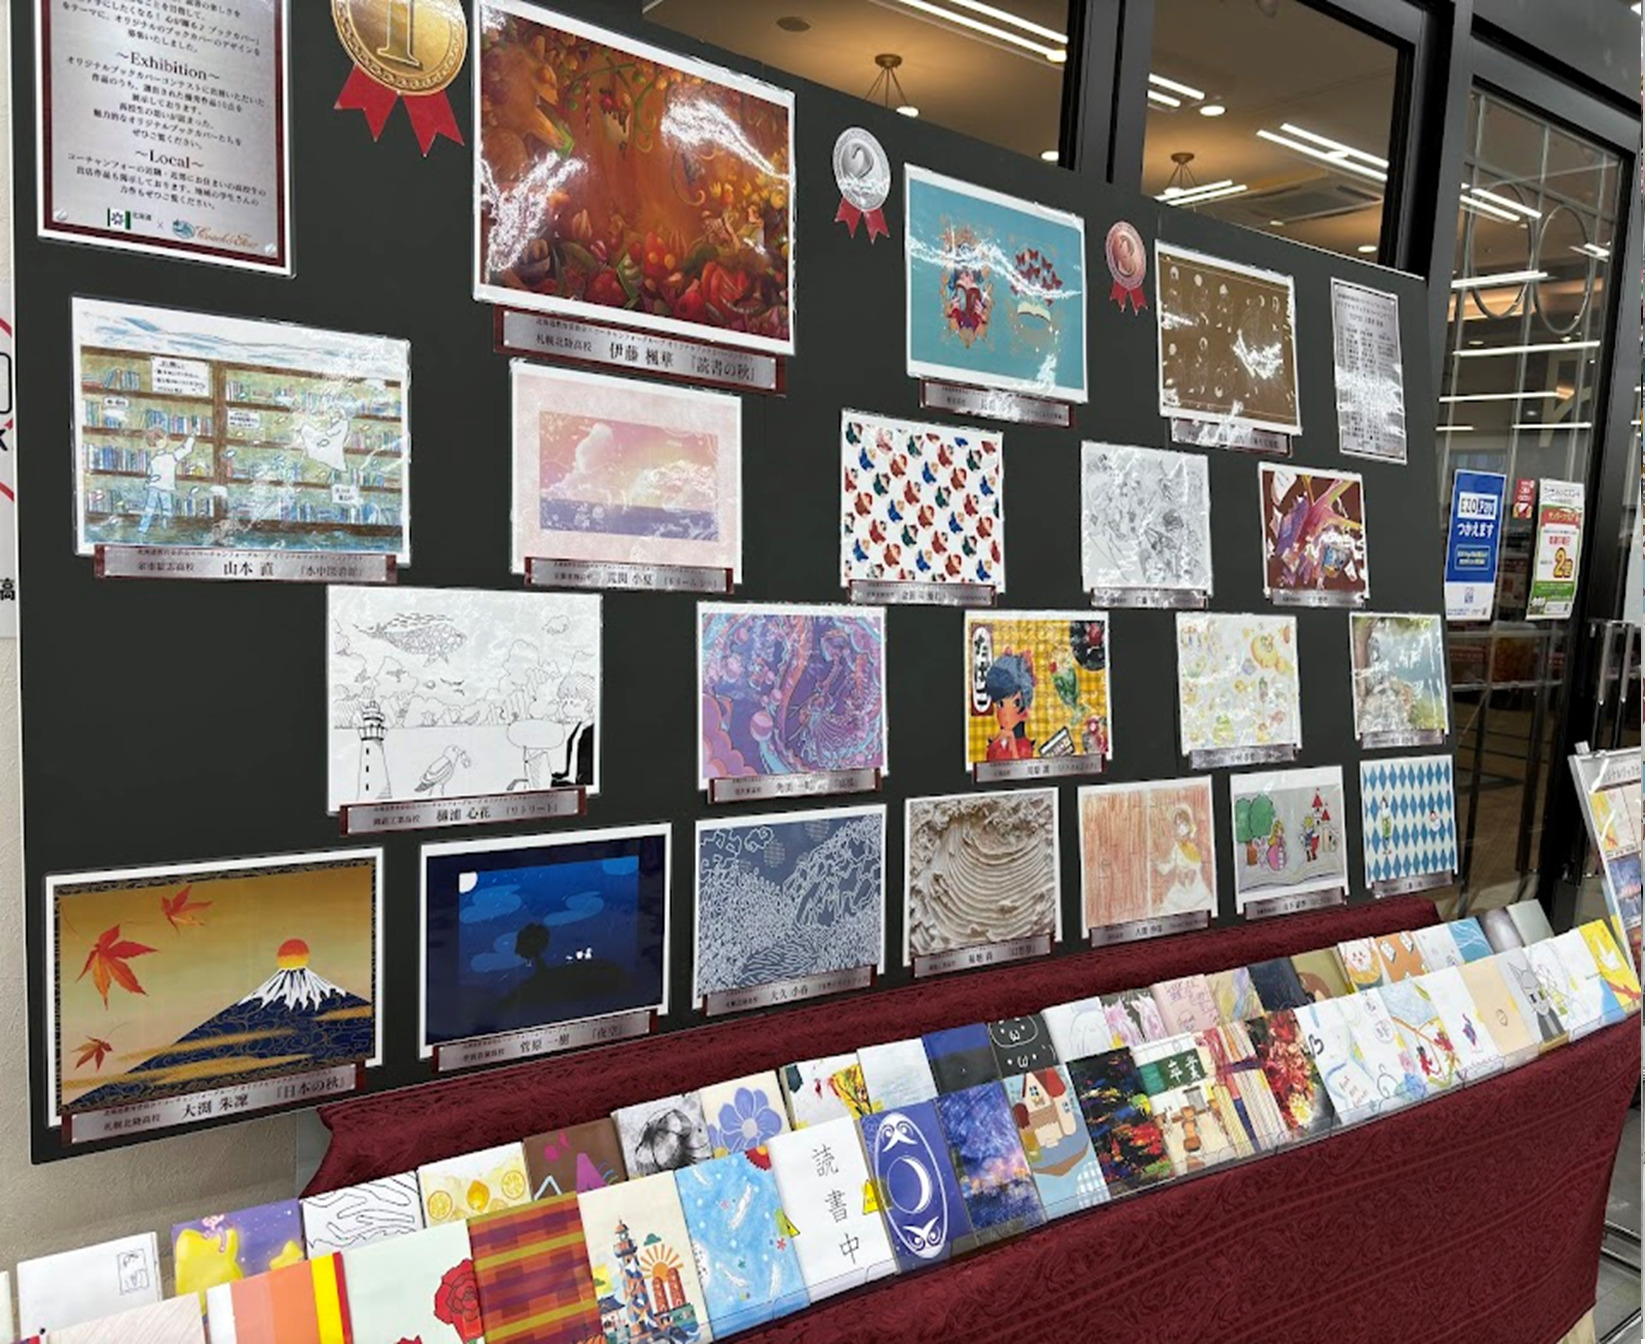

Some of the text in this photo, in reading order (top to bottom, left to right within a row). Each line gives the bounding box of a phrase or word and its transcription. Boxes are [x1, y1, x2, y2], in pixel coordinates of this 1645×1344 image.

[376, 0, 421, 67] 1
[132, 129, 203, 150] ぜひご覧ください。
[608, 341, 639, 363] 伊藤
[1457, 522, 1494, 539] つかえます
[223, 561, 253, 577] 山本
[260, 561, 275, 577] 直
[0, 577, 15, 601] 高
[973, 633, 991, 707] たばこ
[812, 1143, 860, 1264] 読書中
